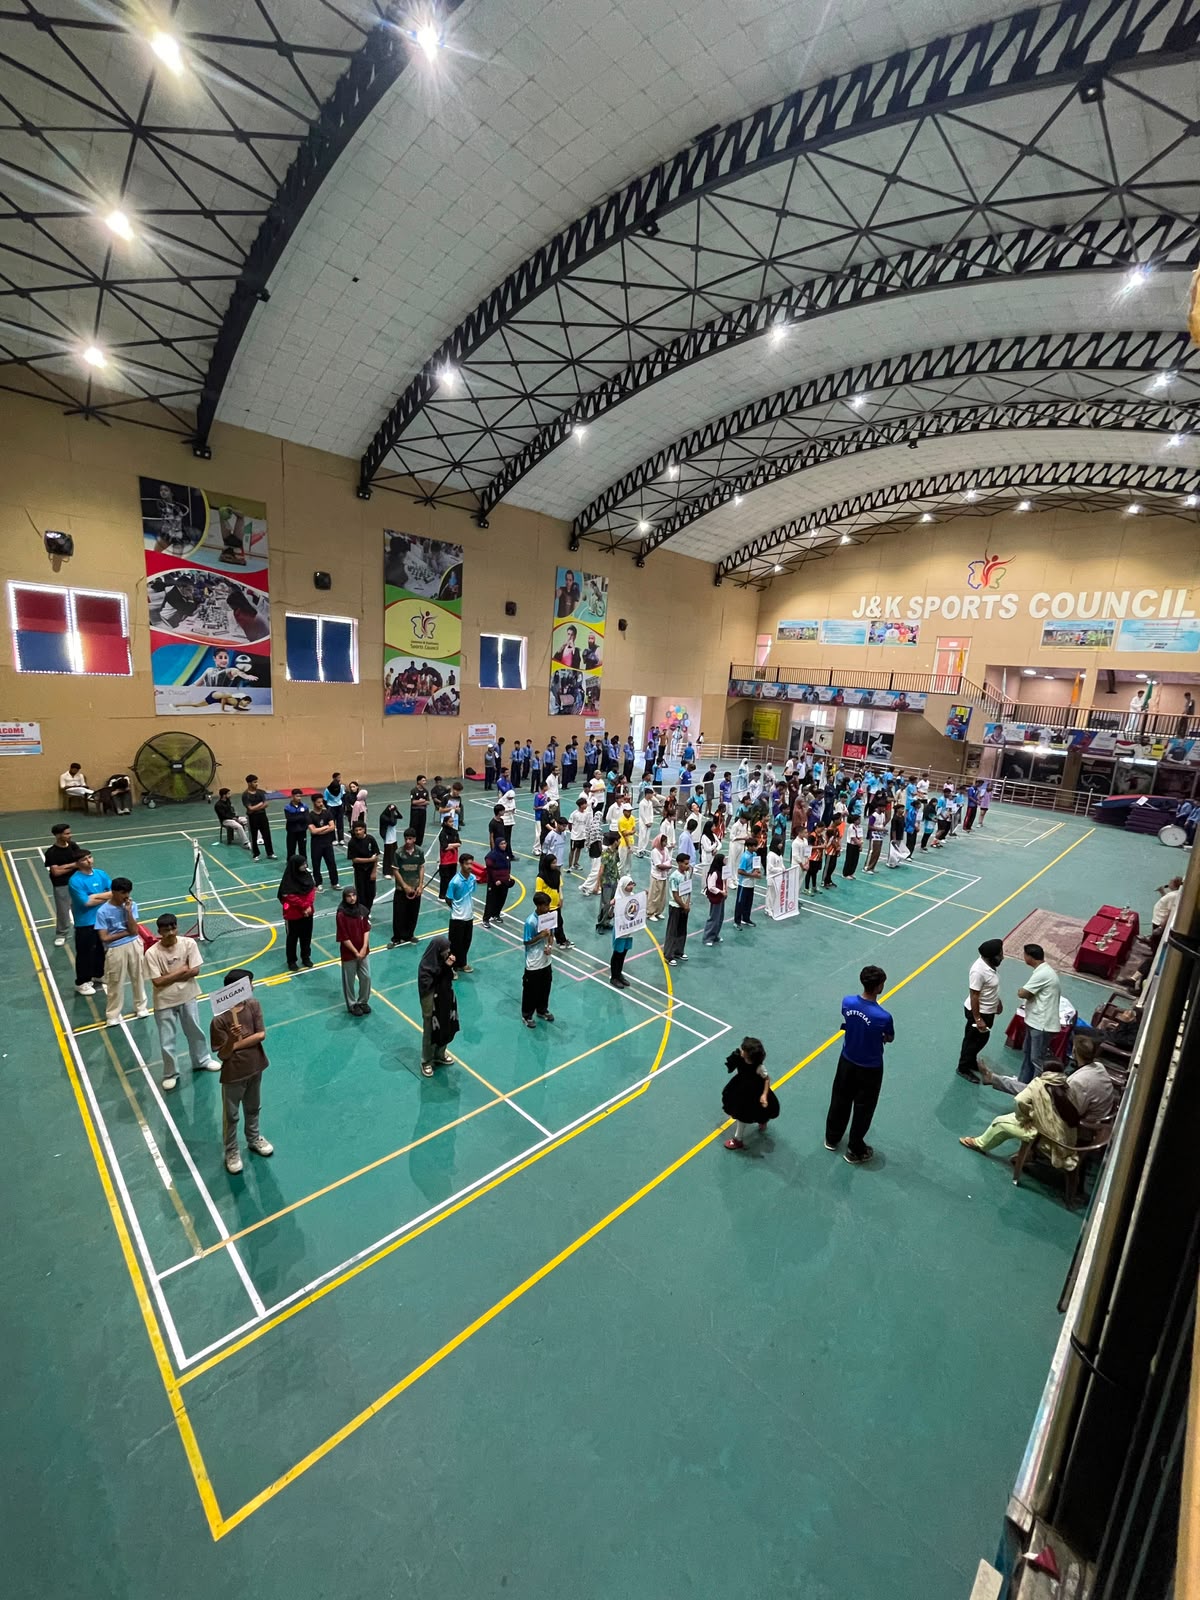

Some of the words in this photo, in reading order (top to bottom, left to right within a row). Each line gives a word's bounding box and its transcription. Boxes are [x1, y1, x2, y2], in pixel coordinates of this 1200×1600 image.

[852, 595, 903, 619] J&K
[906, 593, 1019, 620] SPORTS
[1028, 589, 1196, 619] COUNCIL
[216, 986, 245, 1004] KULGAM
